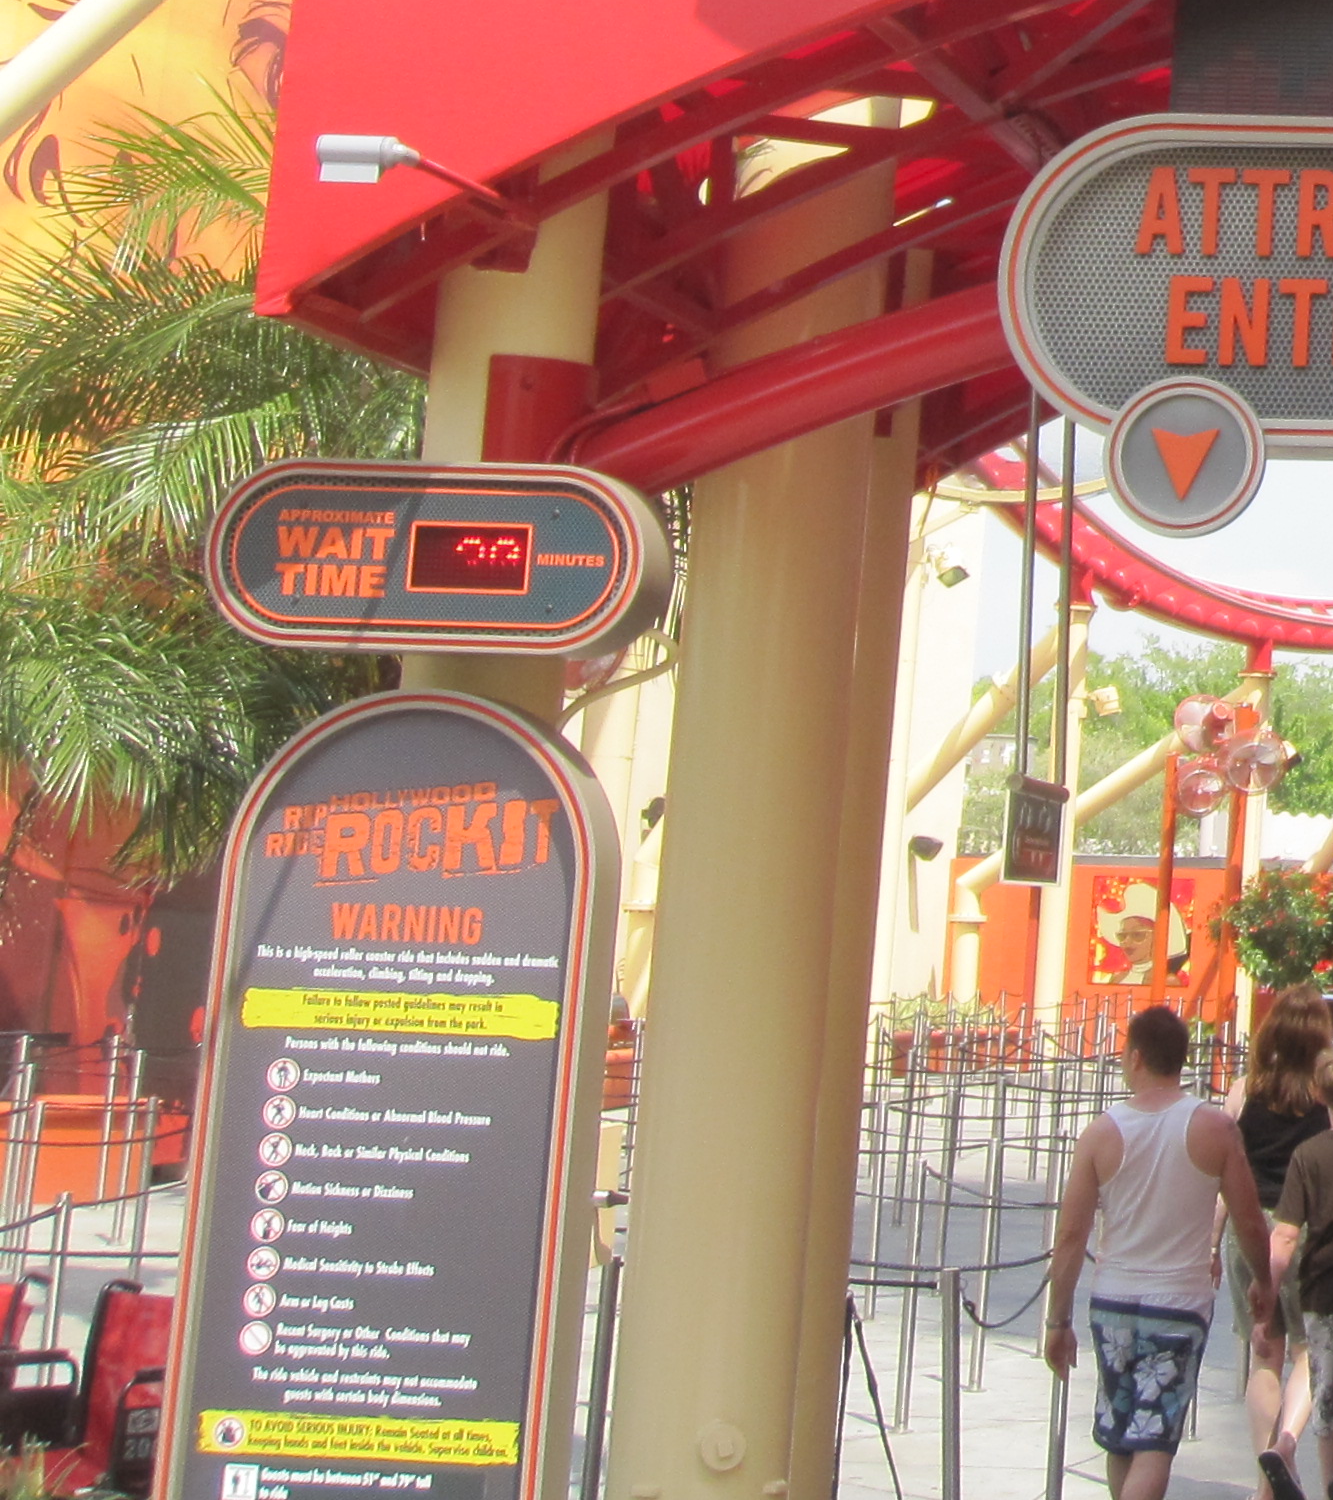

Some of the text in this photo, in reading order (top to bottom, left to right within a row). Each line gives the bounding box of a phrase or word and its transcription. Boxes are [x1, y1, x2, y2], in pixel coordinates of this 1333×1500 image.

[279, 509, 395, 524] APPROXIMATE
[277, 527, 395, 560] WAIT
[537, 553, 604, 568] MINUTES
[275, 564, 386, 598] TIME
[330, 782, 497, 811] HOLLYWOOD
[284, 804, 327, 829] RIP
[265, 829, 325, 857] RIDE
[320, 798, 560, 879] ROCKIT
[331, 903, 483, 945] WARNING
[257, 944, 558, 967] This is a high-speed roller coaster ride that includes sudden and dramatic
[313, 965, 494, 986] acceleration, climbing, tilting and dropping.
[302, 993, 502, 1014] Failure to follow posted guidelines may result in
[314, 1013, 486, 1031] serious injury or expulsion from the park.
[284, 1035, 509, 1056] Persons with the following conditions should not ride.
[302, 1068, 380, 1084] Expectant Mothers
[298, 1105, 490, 1125] Heart Conditions or Abnormal Blood Pressure
[294, 1143, 469, 1162] Neck, Back or Similar Physical Conditions
[290, 1181, 413, 1198] Motion Sickness or Dizziness
[286, 1218, 351, 1236] Fear of Heights
[282, 1256, 434, 1276] Medical Sensitivity to Strobe Effects
[279, 1293, 353, 1311] Arm or Leg Casts
[275, 1322, 470, 1346] Recent Surgery or Other Conditions that may
[274, 1340, 389, 1360] be aggravated by this ride.
[253, 1366, 477, 1389] The ride vehicle and restraints may not accommodate
[283, 1388, 441, 1407] guests with certain body dimensions.
